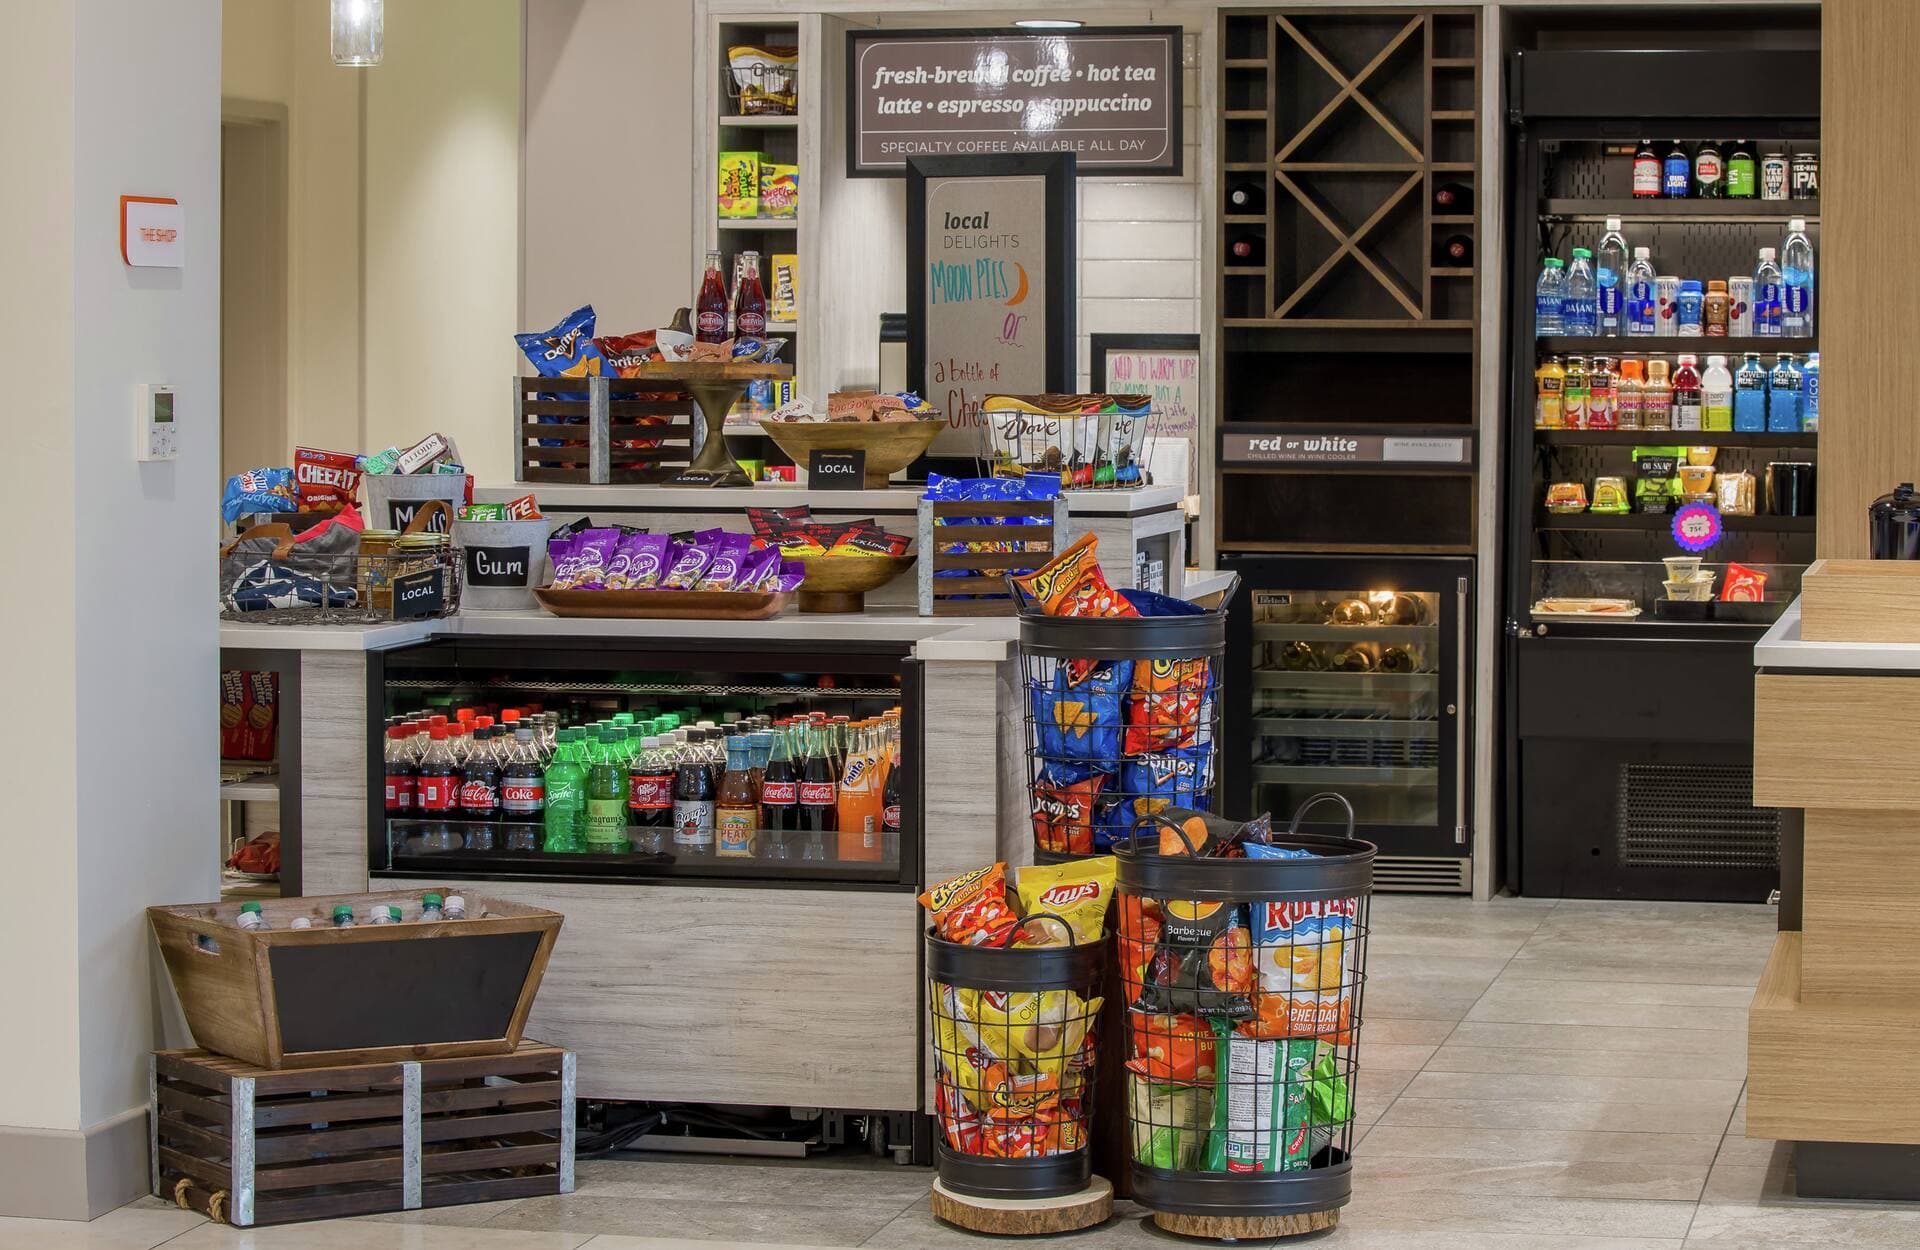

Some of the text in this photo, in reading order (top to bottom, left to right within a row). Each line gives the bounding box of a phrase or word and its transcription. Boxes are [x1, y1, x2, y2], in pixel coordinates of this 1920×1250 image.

[1012, 64, 1071, 87] coffee
[1087, 64, 1119, 81] hot
[1124, 64, 1156, 81] tea
[878, 93, 1152, 117] latte espresso cappuccino
[880, 139, 1146, 153] SPECIALTY COFFEE AVAILABLE ALL DAY
[1728, 169, 1738, 185] IPA
[1793, 173, 1818, 189] IPA
[944, 212, 989, 230] local
[944, 235, 1020, 249] DELIGHTS
[930, 259, 973, 304] MOON
[1565, 302, 1593, 313] DASANI
[544, 327, 585, 361] Doritos
[608, 354, 650, 368] oritos
[935, 361, 945, 383] a
[950, 358, 984, 383] bottle
[997, 417, 1060, 441] Dove
[1249, 436, 1358, 452] red or white
[404, 440, 438, 466] ALTOIDS
[818, 464, 856, 474] LOCAL
[476, 550, 523, 576] Gum
[401, 585, 434, 600] LOCAL
[222, 673, 236, 705] Butter
[231, 670, 244, 702] Nutter
[251, 674, 265, 706] Butter
[261, 671, 273, 703] Nutter
[843, 759, 864, 786] Fanta
[505, 787, 534, 800] Coke
[548, 788, 573, 801] Sprite
[764, 786, 794, 799] Coca-Cola
[802, 786, 832, 799] Coca-Cola
[675, 804, 708, 834] Barq's
[721, 830, 747, 839] PEAK
[1294, 1023, 1312, 1032] SOUR
[1179, 1031, 1209, 1042] MOIE
